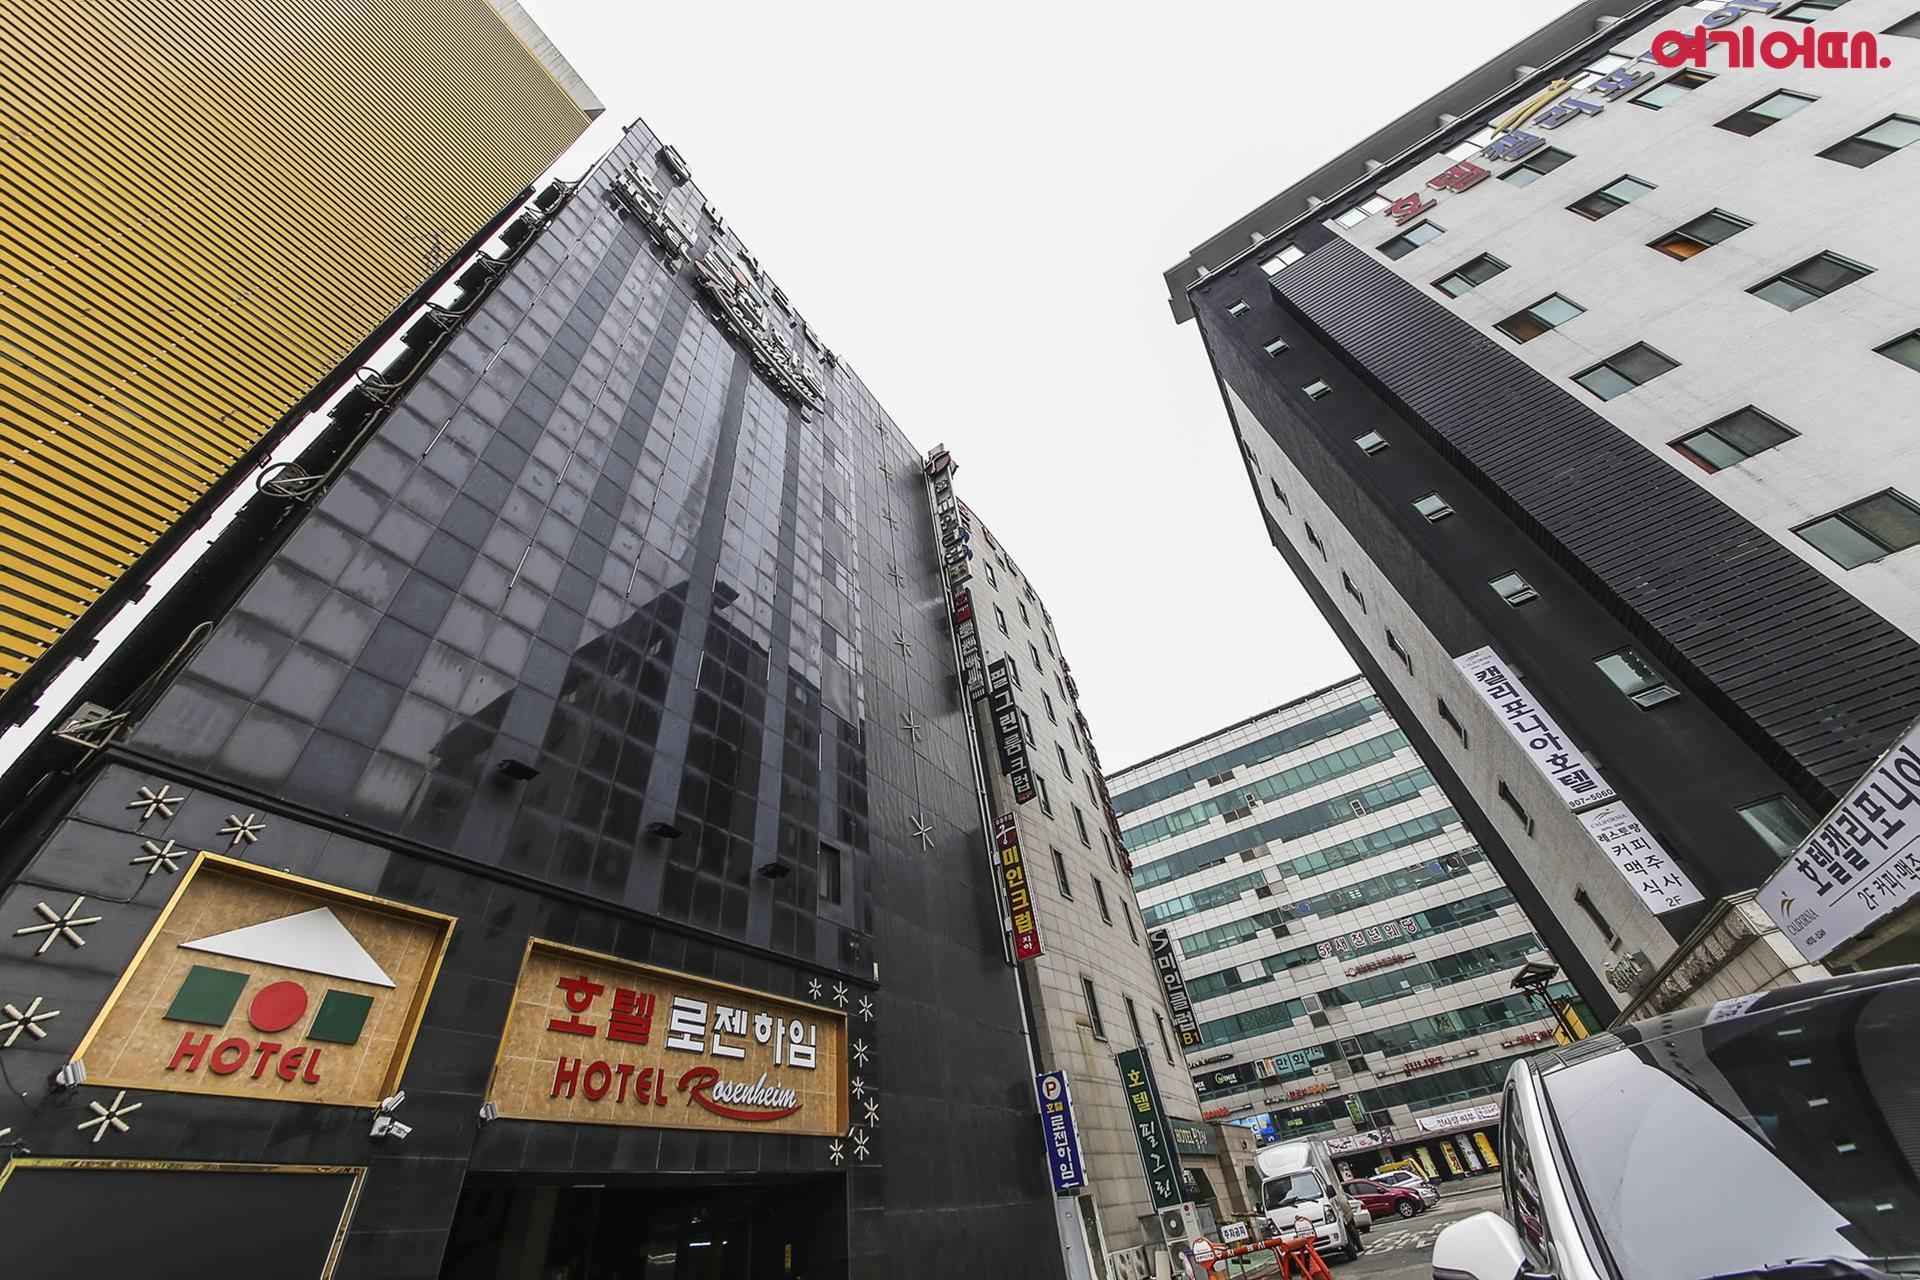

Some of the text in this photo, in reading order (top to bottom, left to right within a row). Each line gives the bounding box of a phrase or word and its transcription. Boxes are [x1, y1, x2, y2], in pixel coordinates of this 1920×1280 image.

[1384, 160, 1492, 227] 호텔
[1568, 789, 1614, 808] 907-5060
[1597, 822, 1641, 843] 레스토랑
[1611, 837, 1652, 857] 커피
[1623, 854, 1665, 876] 맥주
[1002, 845, 1033, 935] 미인크럽
[1642, 872, 1683, 896] 식사
[1665, 895, 1682, 907] 2F
[1857, 887, 1880, 911] 2F
[1318, 941, 1333, 957] 5F
[1158, 952, 1196, 1032] 미인클럽
[547, 975, 819, 1070] 호텔 로젠하임
[1182, 1031, 1199, 1045] B1
[165, 1031, 322, 1084] HOTEL
[550, 1056, 804, 1122] HOTEL Rosenheim
[1045, 1081, 1057, 1097] P
[1127, 1069, 1152, 1113] 호텔
[1050, 1114, 1075, 1180] 로젠하임
[1139, 1121, 1172, 1198] 필그린
